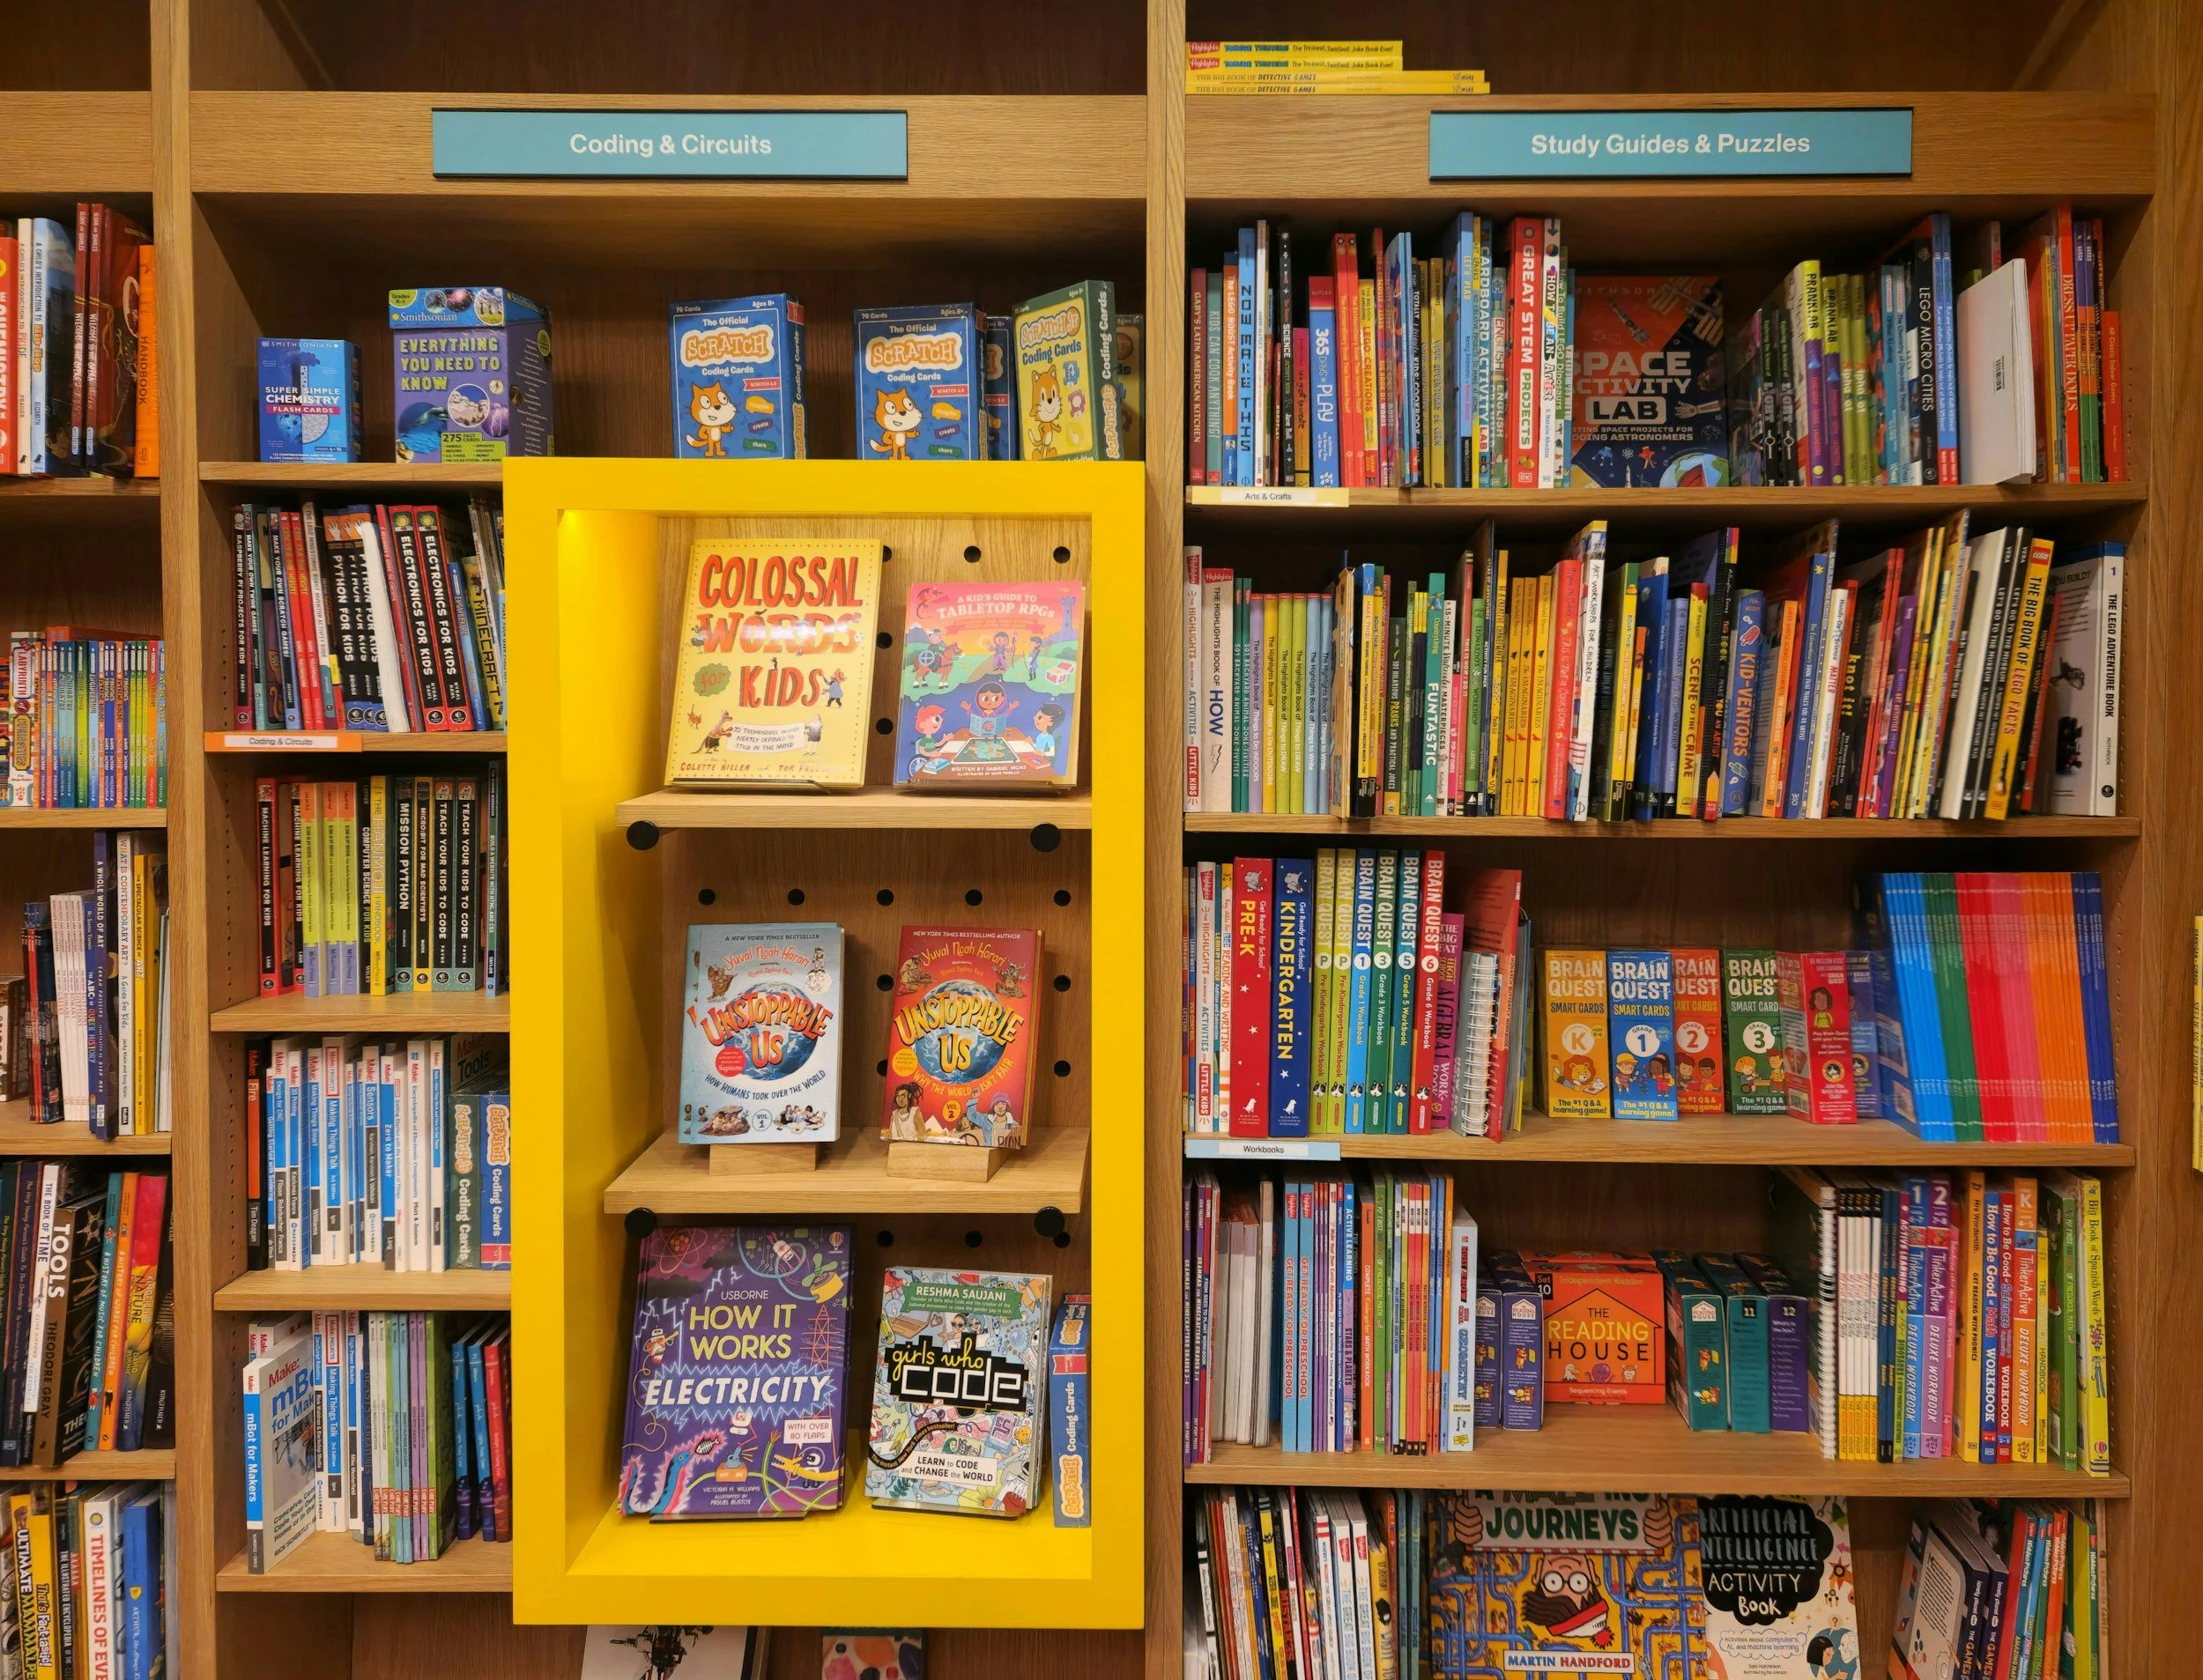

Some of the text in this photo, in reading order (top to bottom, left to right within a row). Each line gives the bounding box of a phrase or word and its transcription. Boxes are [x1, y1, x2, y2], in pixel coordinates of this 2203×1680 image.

[571, 133, 771, 158] Coding & Circuits
[1531, 133, 1810, 157] Study Guides & Puzzles
[1808, 273, 1818, 329] PRANKLAB
[718, 316, 748, 325] Official
[400, 338, 499, 354] EVERYTHING
[686, 331, 769, 360] SCRATCH
[1099, 291, 1111, 381] Coding Cards
[1521, 244, 1534, 447] GREAT STEM PROJECTS
[1919, 287, 1933, 412] LEGO MICRO CITIES
[401, 357, 500, 374] YOU NEED TO
[702, 366, 754, 377] Coding Cards
[1242, 285, 1251, 452] NOW MAKE THIS
[265, 386, 340, 396] SUPER SIMPLE
[402, 375, 448, 391] KNOW
[265, 394, 340, 405] CHEMISTRY
[1593, 402, 1659, 420] LAB
[699, 555, 863, 608] COLOSSAL
[333, 555, 353, 661] PYTHON FOR KIDS
[401, 536, 433, 676] ELECTRONICS FOR KIDS
[938, 603, 1054, 618] TABLETOP RPGs
[992, 594, 1021, 603] GUIDE
[697, 612, 862, 654] WORDS
[2107, 637, 2117, 691] ADVENTURE
[738, 665, 824, 707] KIDS
[1689, 658, 1701, 701] SCENE
[1209, 690, 1223, 736] HOW
[1690, 703, 1697, 715] OF
[1732, 653, 1755, 757] KID-VENTORS
[2104, 693, 2114, 718] BOOK
[1426, 683, 1436, 766] FUNTASTIC
[1683, 733, 1695, 778] CRIME
[399, 803, 409, 910] MISSION PYTHON
[120, 876, 130, 943] CONTEMPORARY
[439, 896, 446, 909] TO
[1355, 857, 1374, 949] BRAIN QUEST
[1240, 900, 1256, 957] PRE-K
[1359, 955, 1366, 967] 1
[1548, 959, 1603, 978] BRAIN
[1612, 961, 1668, 980] BRAIN
[1278, 901, 1295, 1059] KINDERGARTEN
[1548, 980, 1603, 1000] QUEST
[1611, 981, 1671, 1003] QUEST
[701, 992, 833, 1046] UNSTOPPABLE
[894, 992, 1024, 1047] UNSTOPPABLE
[1614, 1004, 1670, 1018] SMART CARDS
[752, 1030, 783, 1069] US
[939, 1033, 971, 1072] US
[1572, 1032, 1586, 1051] K
[1638, 1034, 1647, 1052] 1
[1687, 1031, 1699, 1048] 2
[1754, 1030, 1766, 1048] 3
[705, 1074, 720, 1088] HOW
[721, 1083, 750, 1099] HUMANS
[771, 1088, 788, 1099] OVER
[790, 1084, 802, 1094] THE
[802, 1070, 827, 1090] WORLD
[367, 1087, 375, 1121] Sensors
[38, 1235, 48, 1262] TIME
[48, 1223, 70, 1299] TOOLS
[721, 1290, 768, 1300] USBORNE
[916, 1286, 1005, 1301] RESHMA SAUJANI
[1539, 1284, 1551, 1295] 10
[690, 1304, 797, 1330] HOW IT
[1588, 1307, 1609, 1318] THE
[1548, 1322, 1649, 1341] READING
[691, 1336, 790, 1361] WORKS
[893, 1338, 983, 1381] girls who
[1549, 1343, 1649, 1360] HOUSE
[42, 1321, 56, 1419] THEODORE GRAY
[901, 1358, 1021, 1403] code
[1927, 1325, 1940, 1423] DELUXE WORKBOOK
[645, 1377, 830, 1406] ELECTRICITY
[1984, 1348, 1996, 1423] WORKBOOK
[1066, 1381, 1079, 1452] Coding Cards
[914, 1467, 948, 1477] CHANGE
[962, 1471, 992, 1483] WORLD
[917, 1456, 946, 1466] LEARN
[955, 1460, 978, 1469] CODE
[248, 1464, 256, 1502] Makers
[1486, 1506, 1638, 1540] JOURNEYS
[17, 1528, 33, 1594] ULTIMATE
[92, 1535, 108, 1647] TIMELINES OF
[1709, 1573, 1800, 1592] ACTIVITY
[1739, 1596, 1781, 1616] BOOK
[1509, 1655, 1631, 1669] MARTIN HANDFORD
